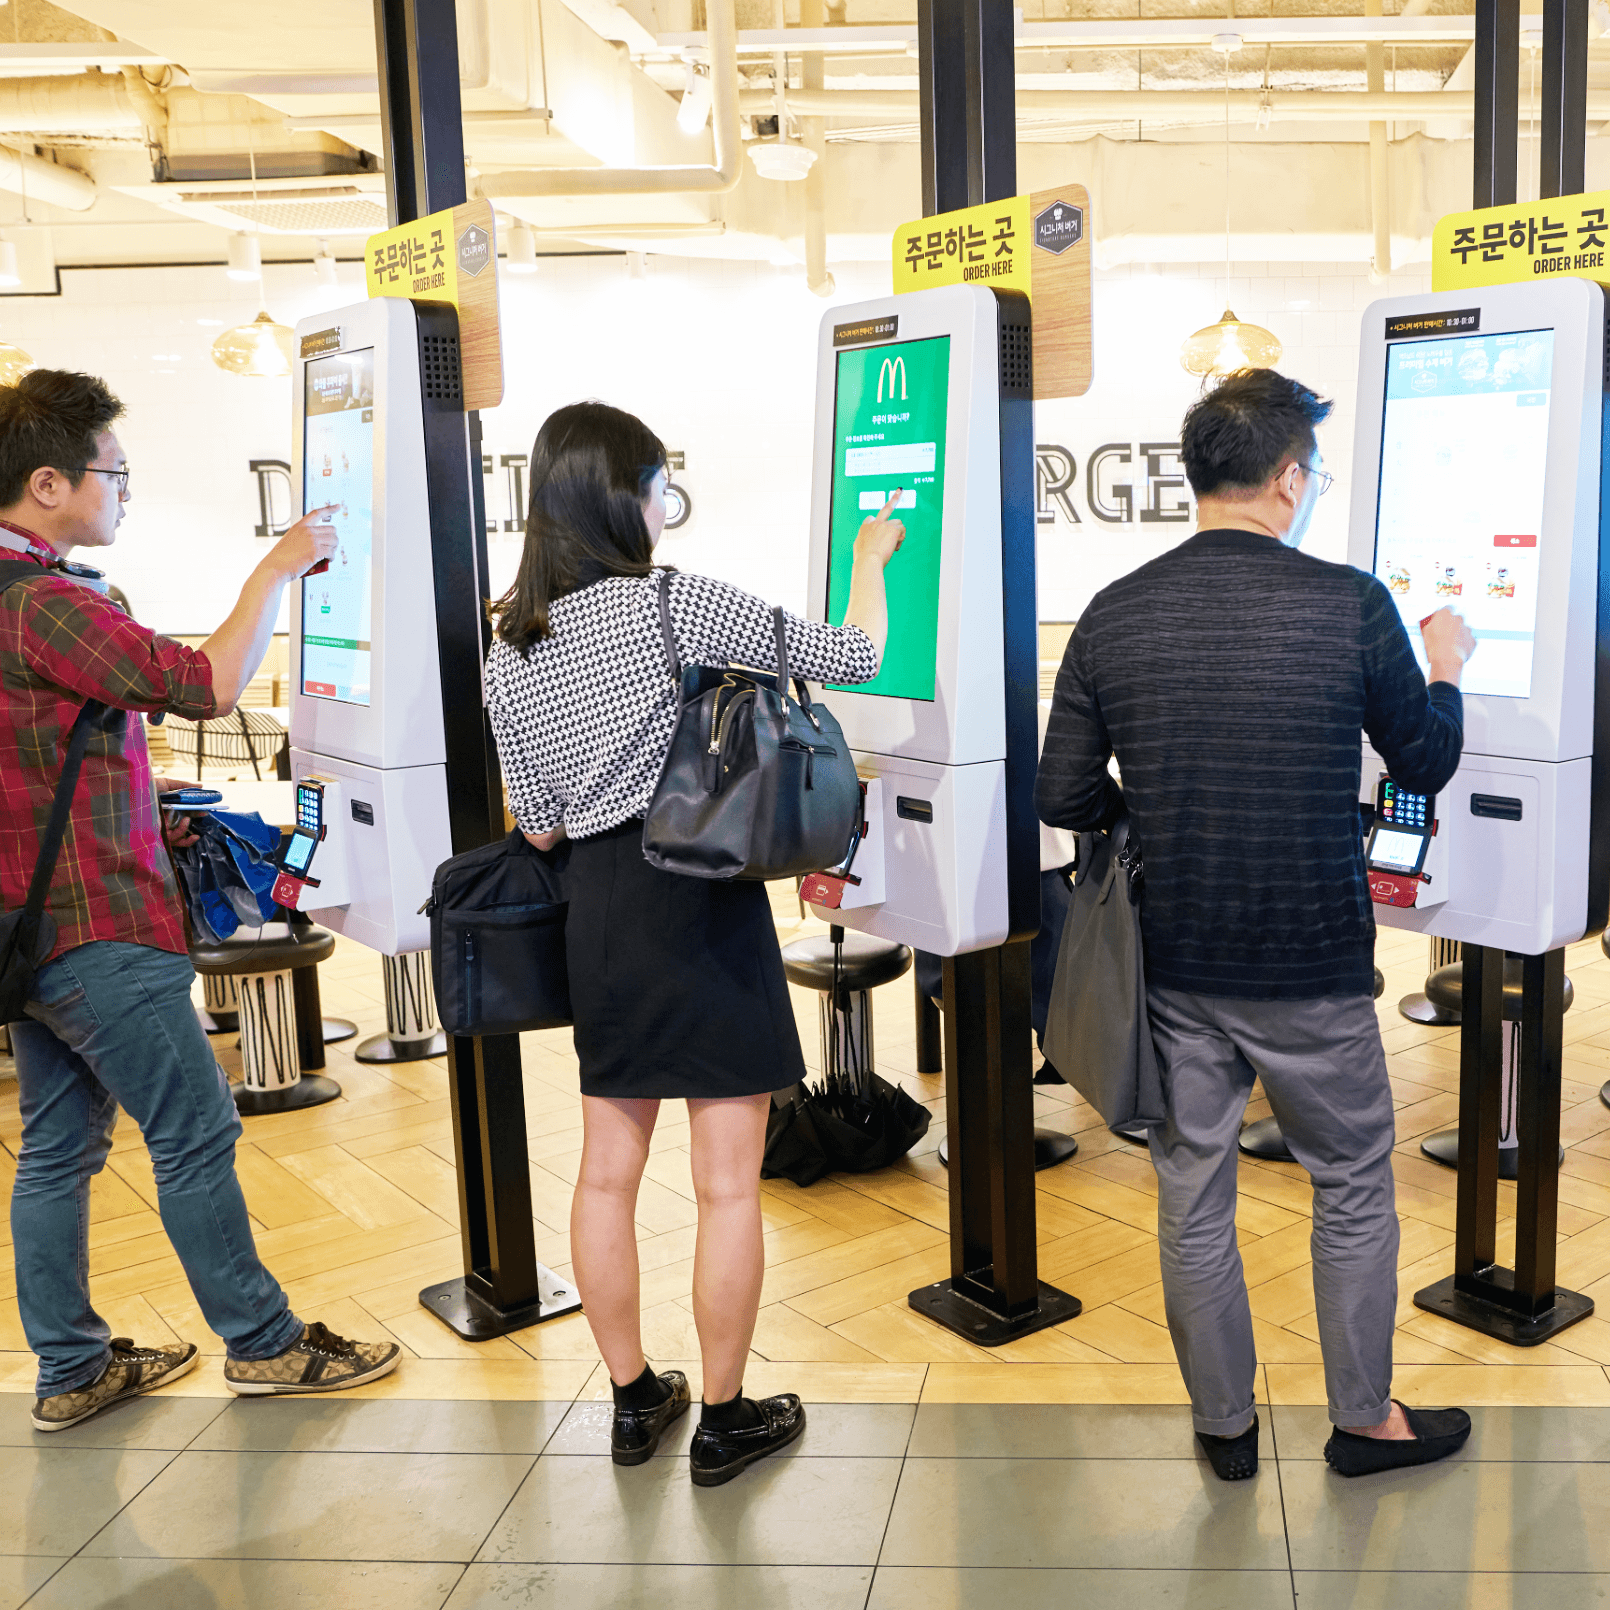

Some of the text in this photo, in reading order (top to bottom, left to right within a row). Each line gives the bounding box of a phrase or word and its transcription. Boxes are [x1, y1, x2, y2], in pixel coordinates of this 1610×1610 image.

[905, 215, 1015, 273] 주문하는 곳
[1040, 219, 1078, 236] 시그니처 버거
[1450, 208, 1609, 265] 주문하는 곳
[374, 229, 445, 285] 주문하는 곳
[963, 259, 1013, 281] ORDER HERE
[1533, 252, 1605, 274] ORDER HERE
[413, 272, 445, 294] ORDER HERE
[1036, 442, 1191, 524] RGE
